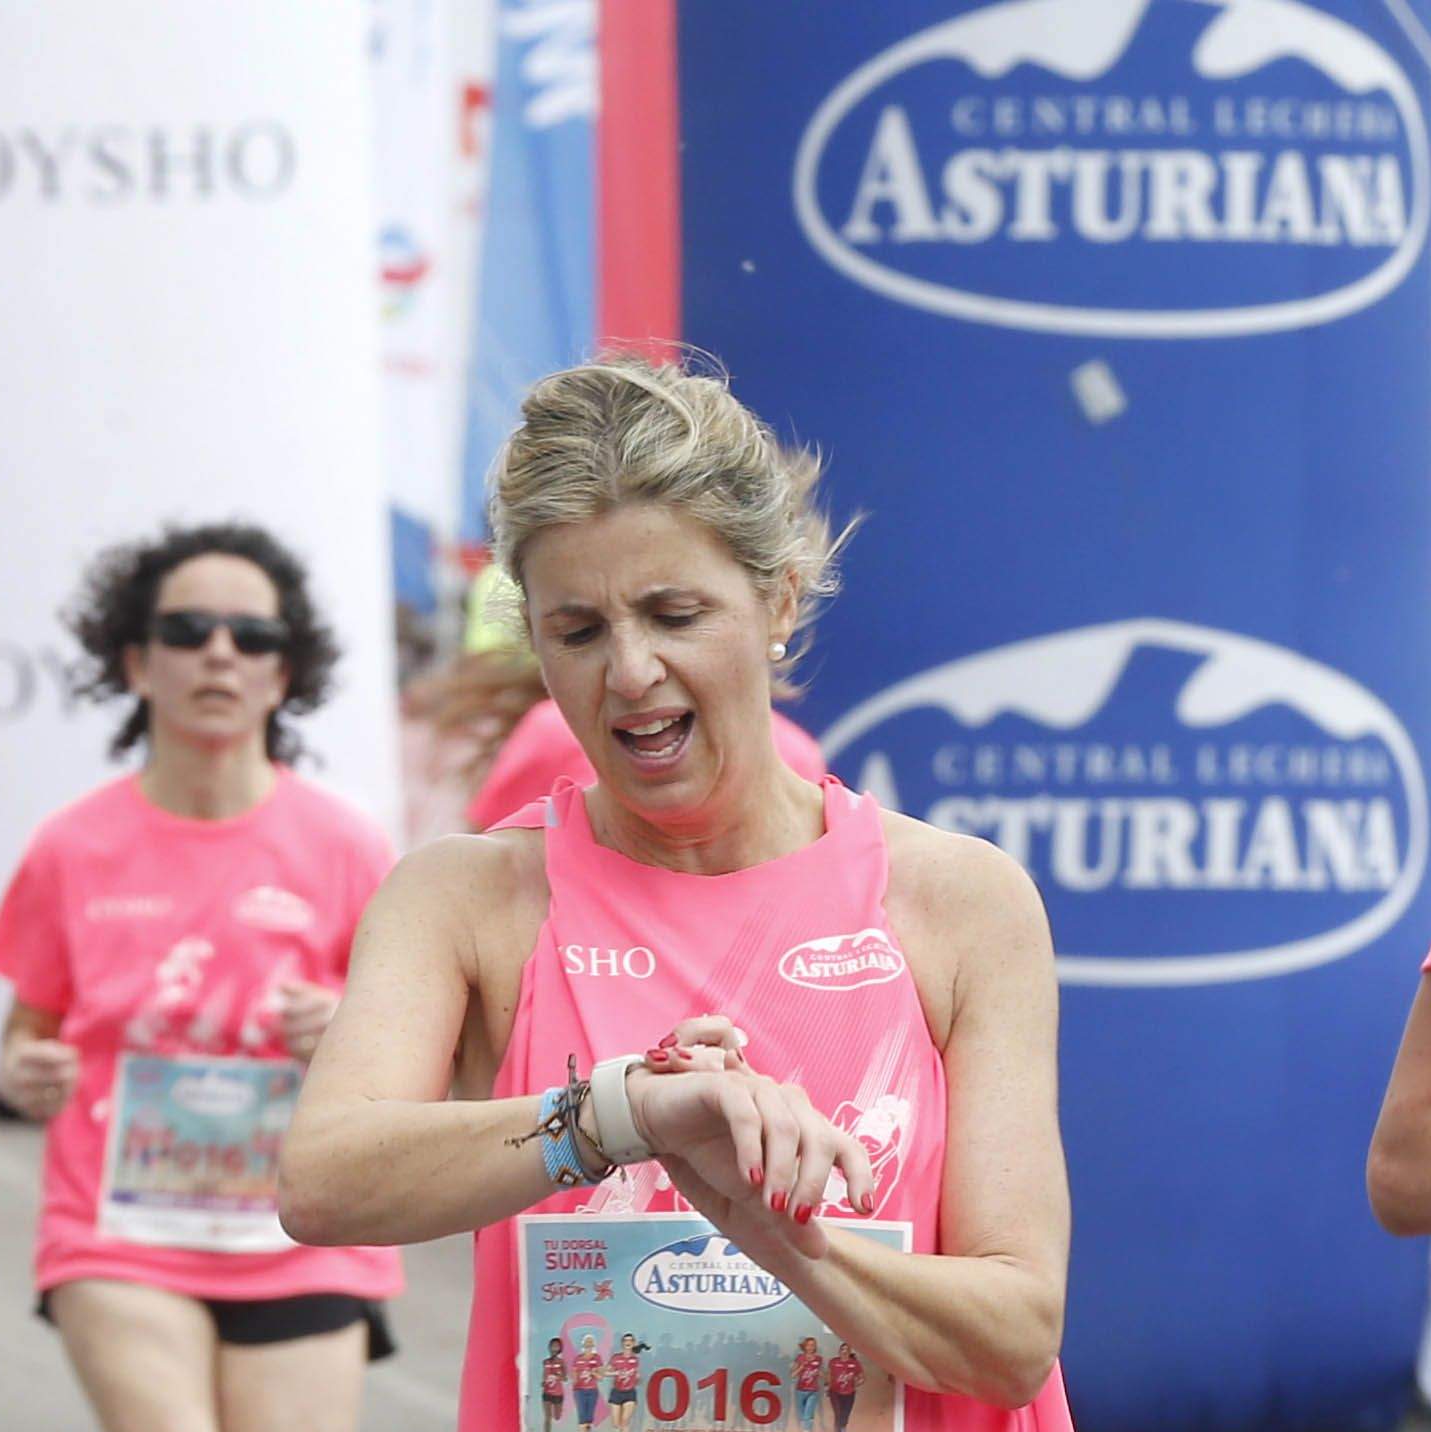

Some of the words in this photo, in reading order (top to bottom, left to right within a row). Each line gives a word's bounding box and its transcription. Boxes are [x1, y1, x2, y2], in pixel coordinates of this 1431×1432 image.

[951, 95, 1196, 136] CENTRAL
[841, 103, 1407, 245] ASTURIANA
[932, 744, 1178, 785] CENTRAL
[558, 944, 656, 979] SHO
[545, 1252, 607, 1270] SUMA
[644, 1264, 783, 1296] ASTURIANA
[646, 1368, 783, 1424] 016
